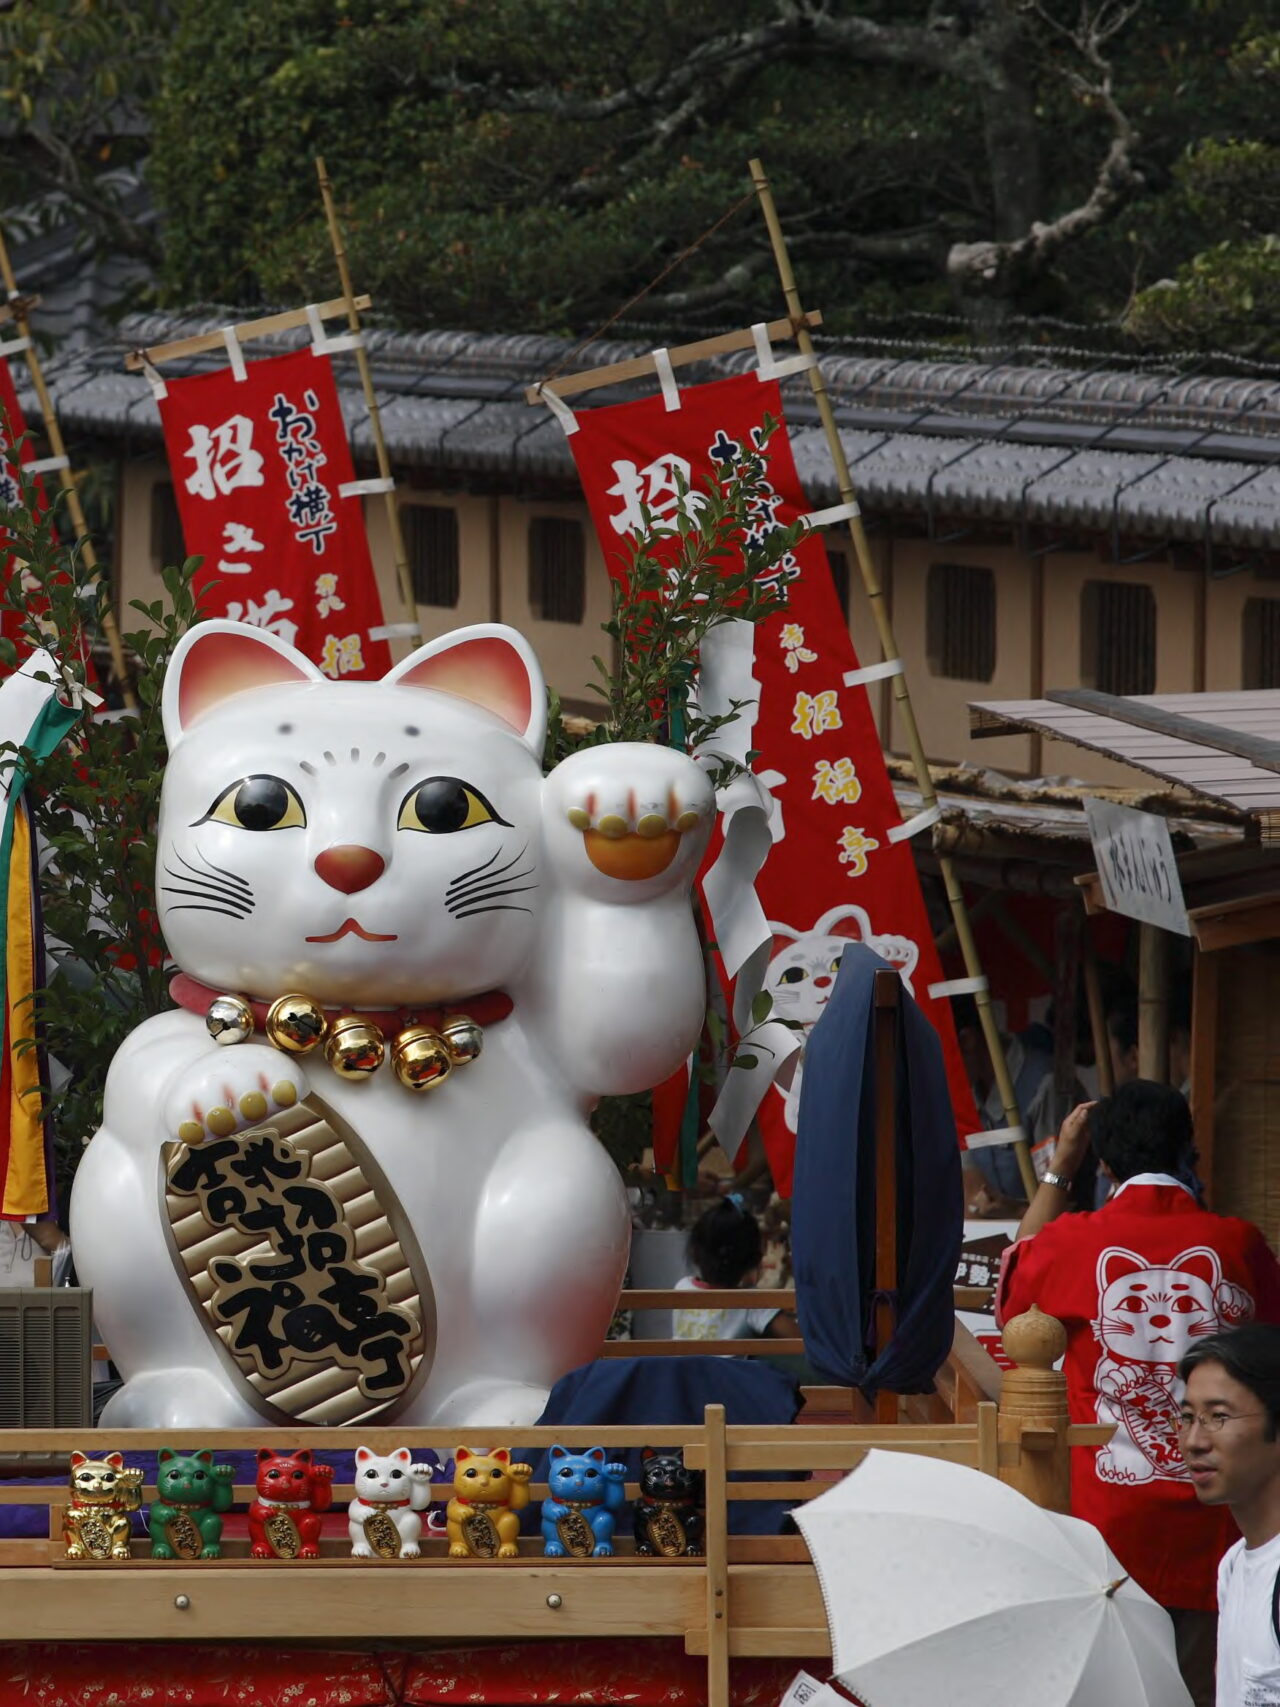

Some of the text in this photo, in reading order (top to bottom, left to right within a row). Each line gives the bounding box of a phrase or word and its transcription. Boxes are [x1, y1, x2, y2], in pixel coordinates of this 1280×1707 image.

[270, 388, 338, 556] おかげ横丁
